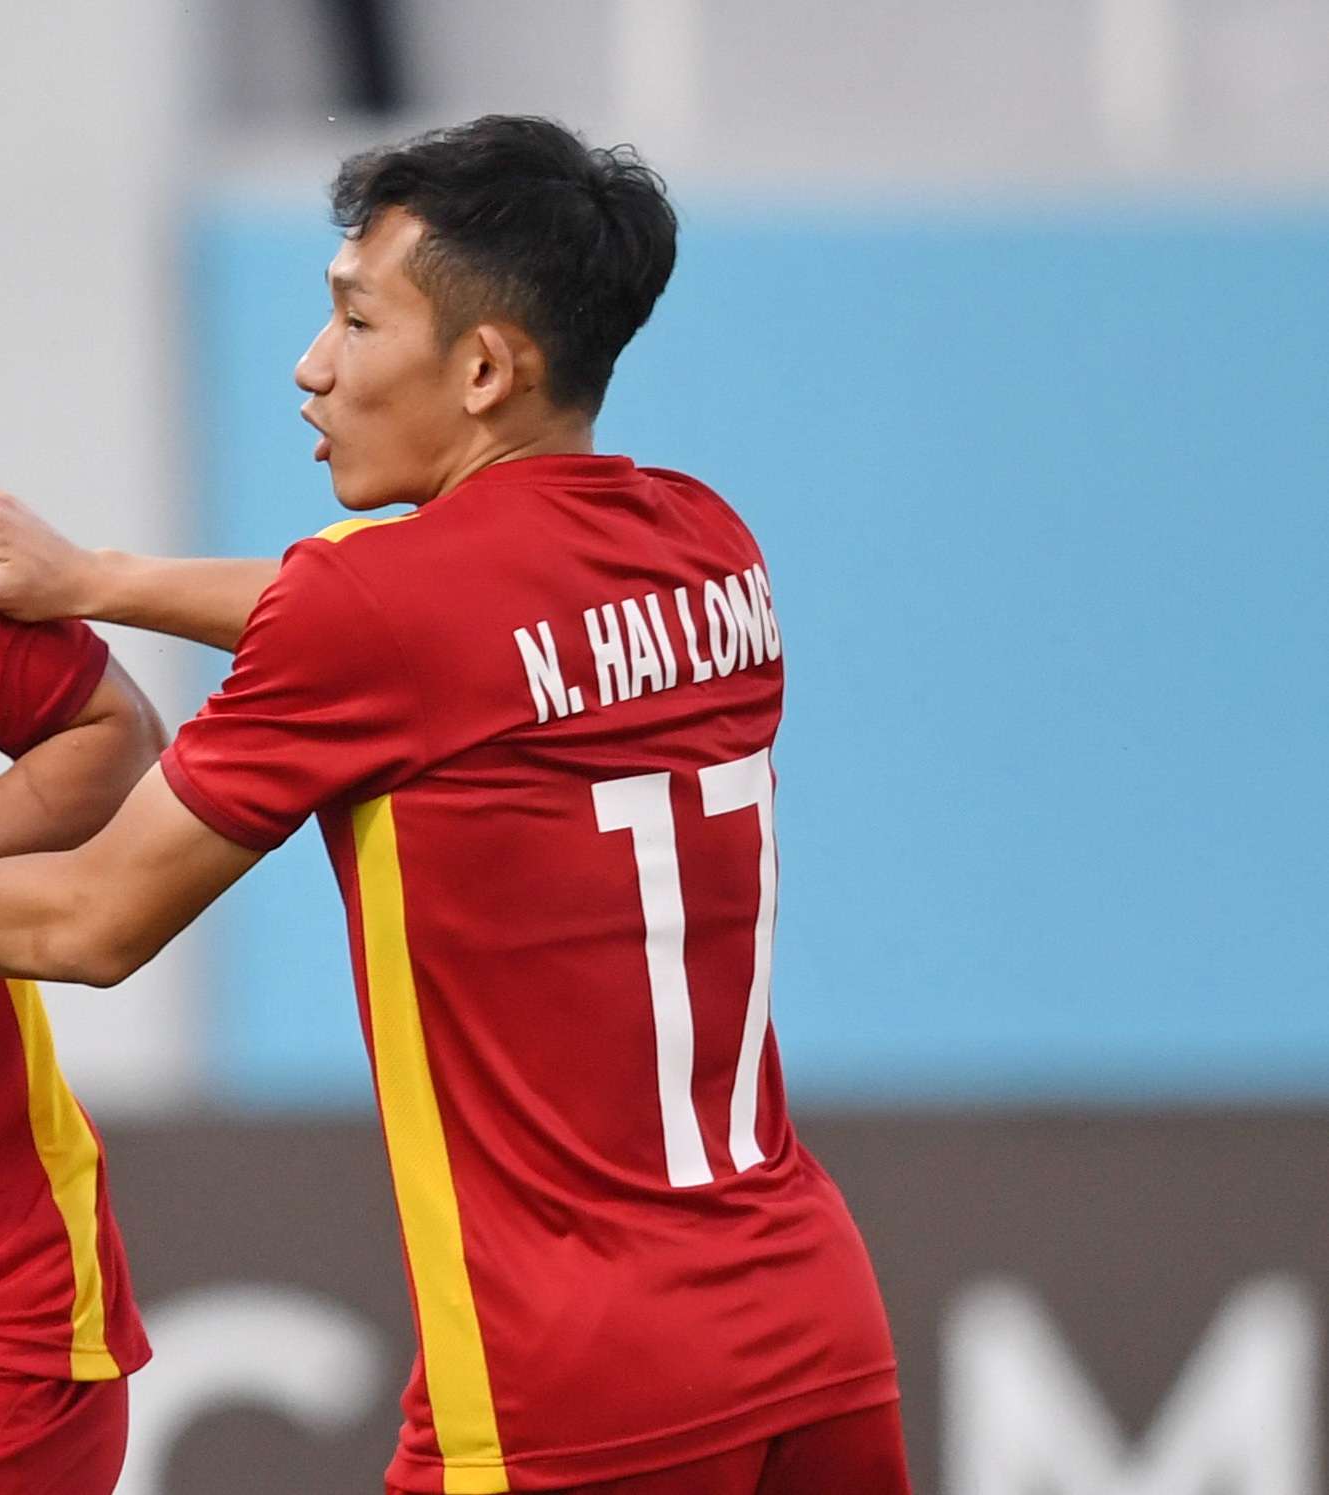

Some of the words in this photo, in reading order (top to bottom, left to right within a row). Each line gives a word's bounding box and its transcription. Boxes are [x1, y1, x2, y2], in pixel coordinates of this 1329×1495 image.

[513, 621, 585, 724] N.
[583, 592, 677, 707] HAI
[674, 563, 781, 683] LONG
[590, 746, 777, 1188] 17
